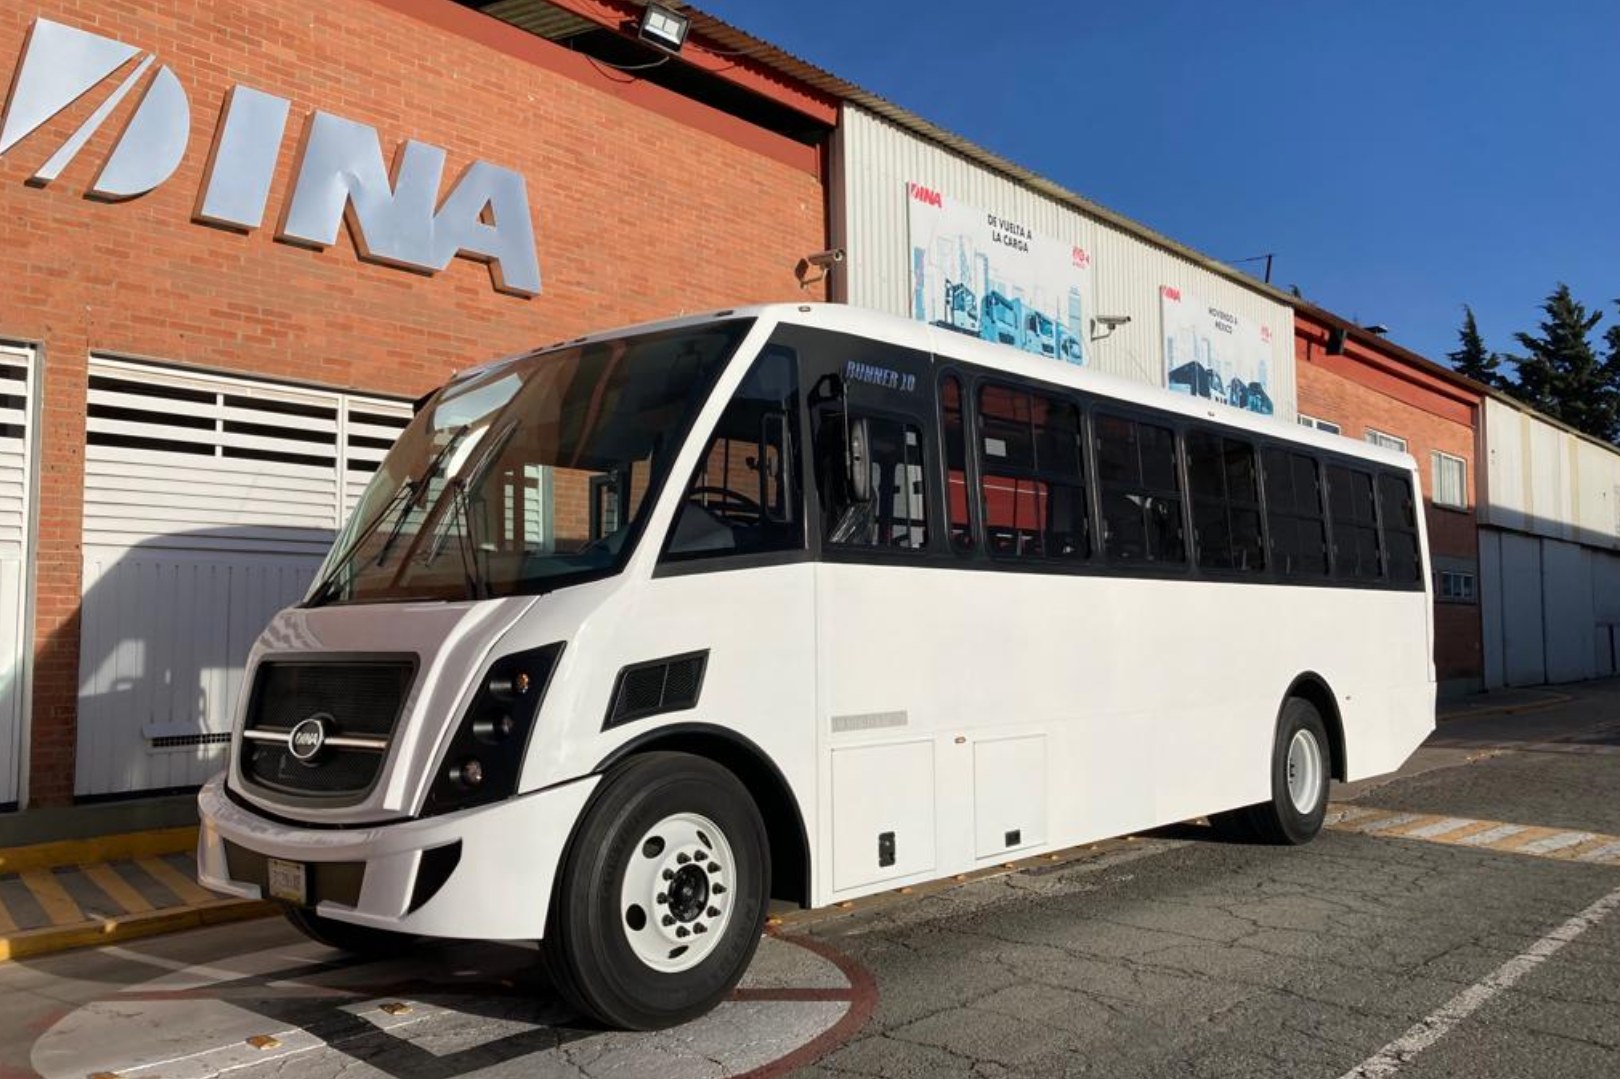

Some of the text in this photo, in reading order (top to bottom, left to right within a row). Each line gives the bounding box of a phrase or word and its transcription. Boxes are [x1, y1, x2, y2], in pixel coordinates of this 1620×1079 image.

[0, 18, 542, 297] DINA
[910, 183, 942, 208] DINA
[987, 214, 1032, 240] DE VUELTA A
[992, 229, 1028, 253] LA CARGA
[846, 360, 916, 392] RUNNER 10
